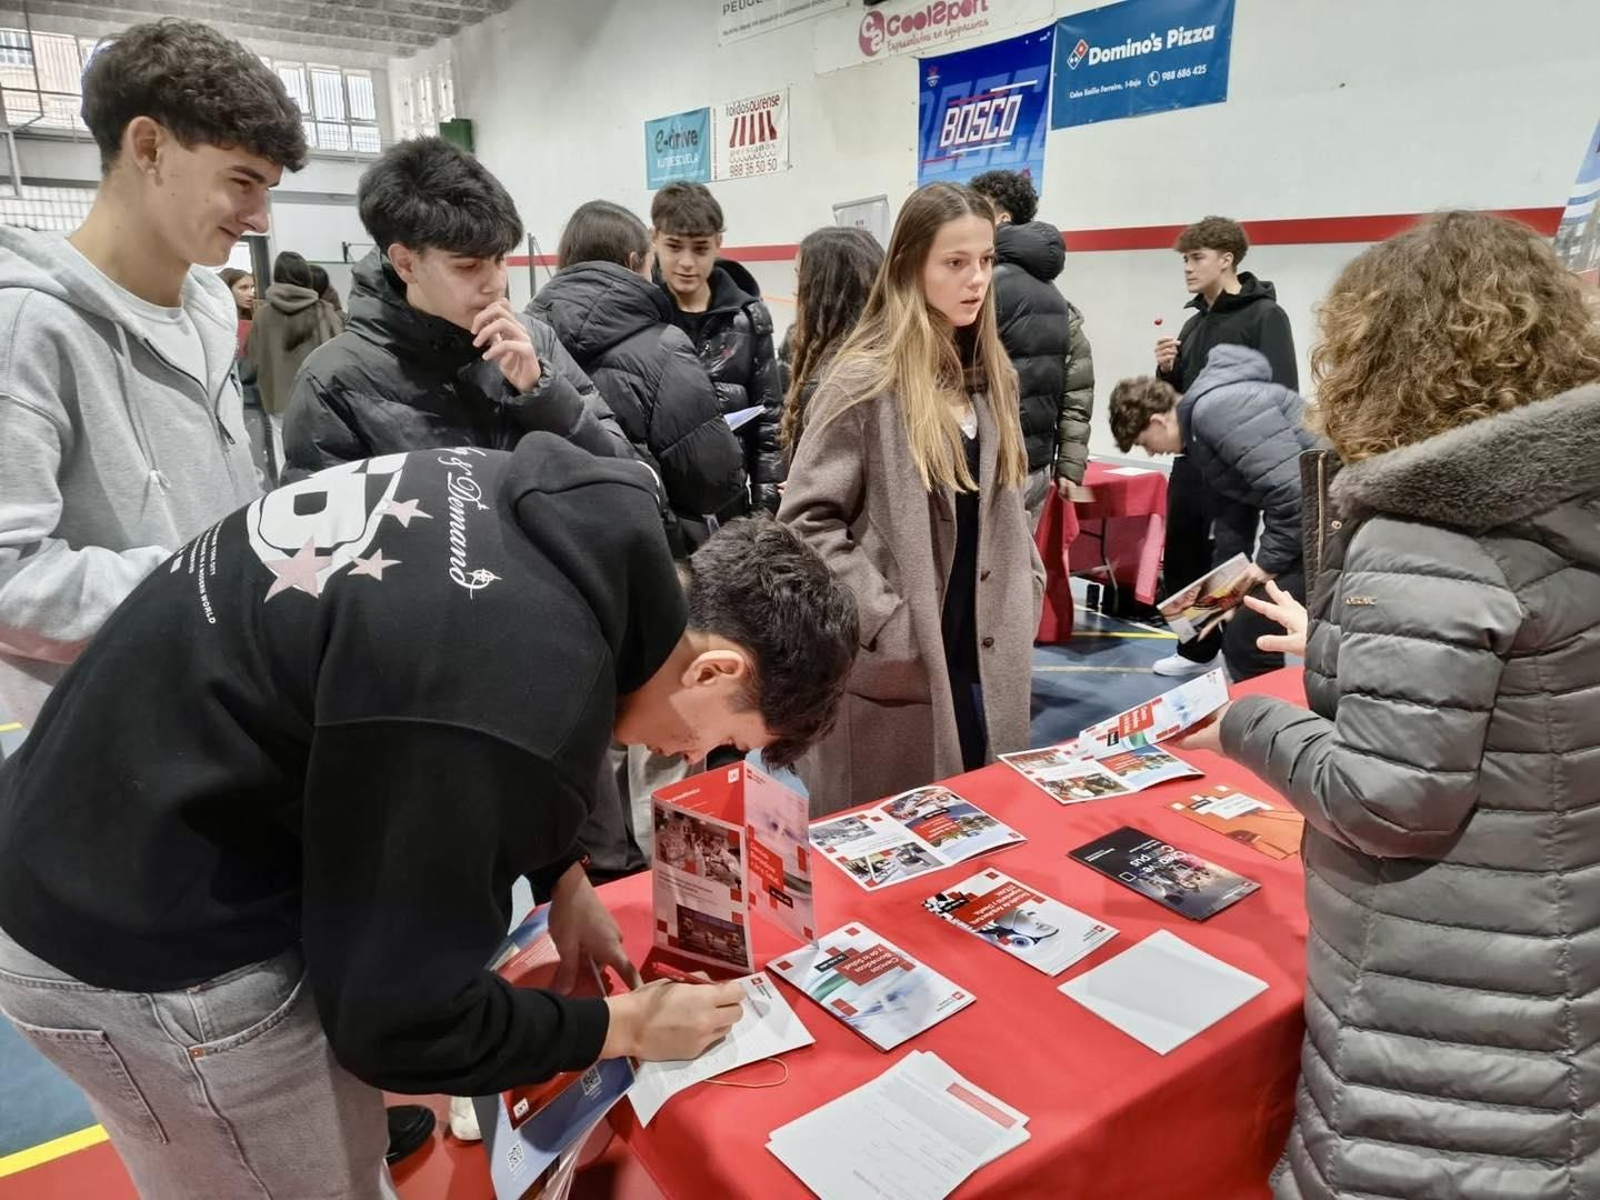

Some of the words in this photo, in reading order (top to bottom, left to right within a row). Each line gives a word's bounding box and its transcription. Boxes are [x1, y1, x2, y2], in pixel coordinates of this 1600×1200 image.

[1088, 33, 1162, 66] Domino's
[1166, 25, 1215, 49] Pizza
[1162, 69, 1175, 81] 988
[1177, 67, 1191, 79] 686
[1192, 64, 1207, 75] 425
[940, 94, 1023, 148] BOSCO
[655, 128, 698, 153] e-drive
[448, 471, 502, 600] Demand
[200, 593, 216, 624] WORLD
